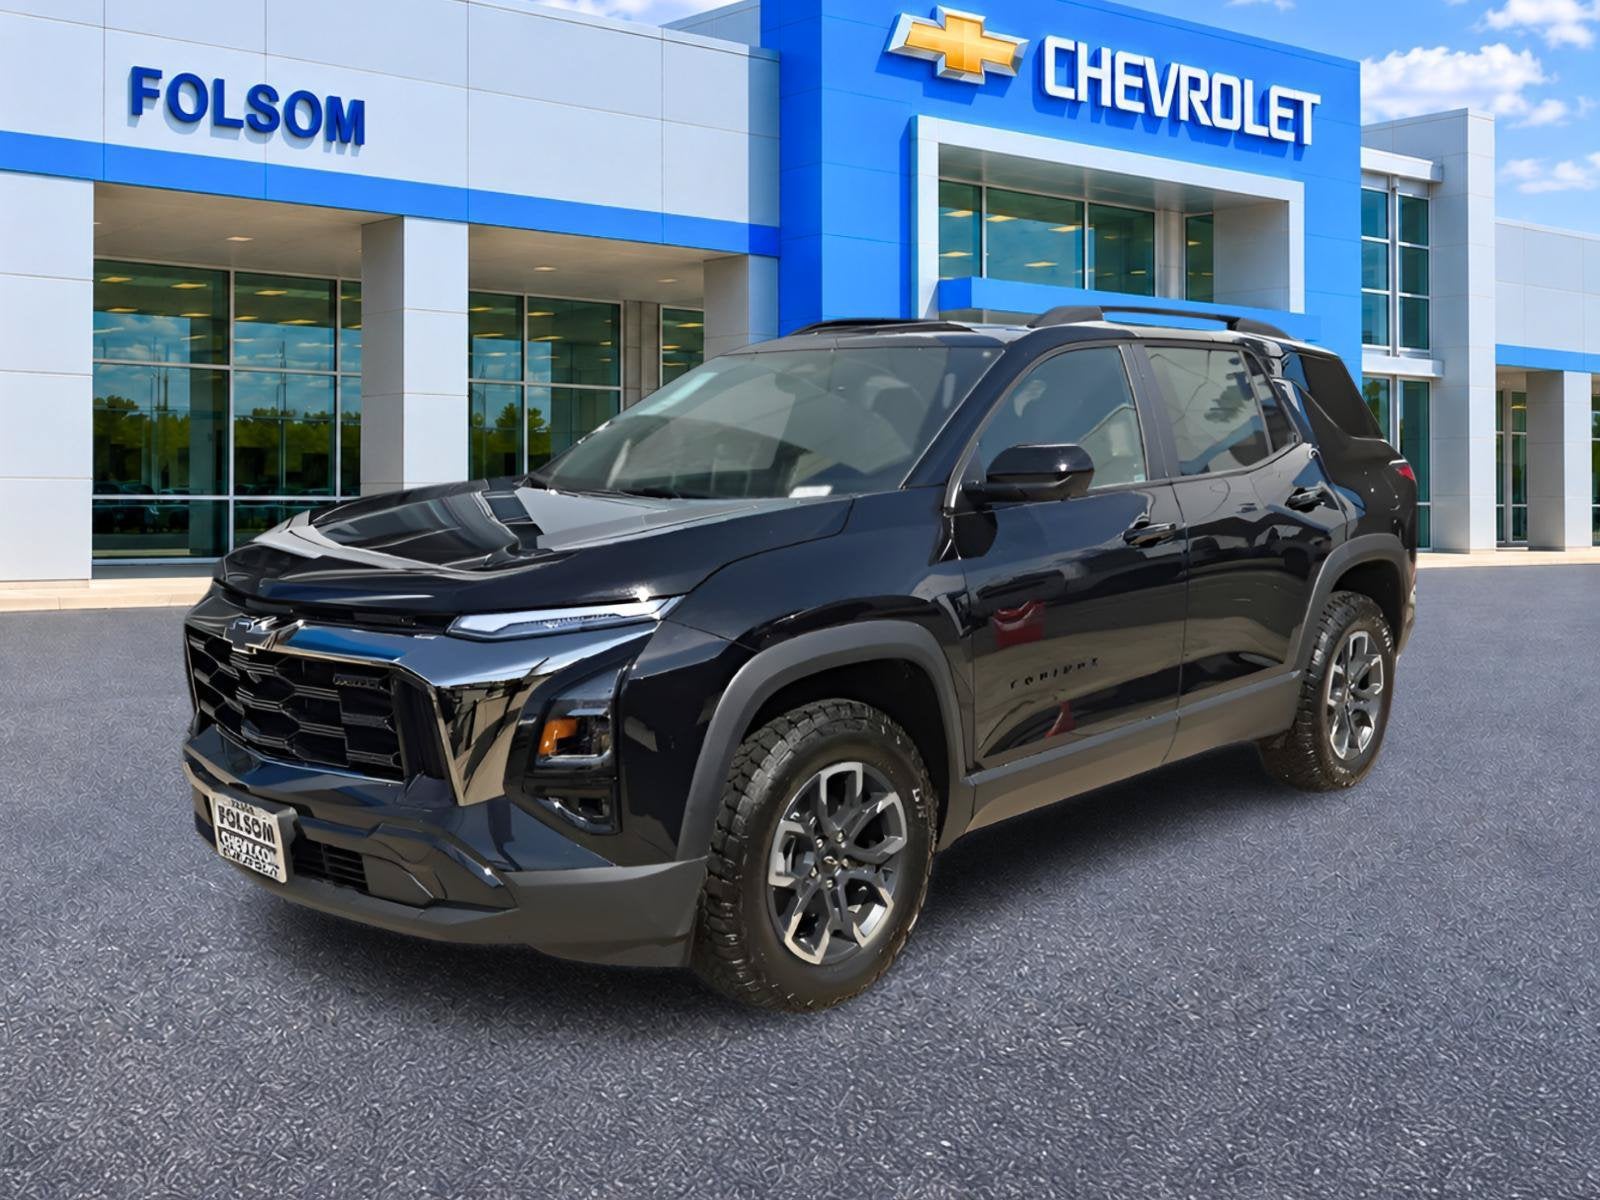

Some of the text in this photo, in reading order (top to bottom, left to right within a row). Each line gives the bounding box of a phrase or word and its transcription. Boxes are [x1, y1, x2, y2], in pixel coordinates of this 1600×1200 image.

[131, 65, 366, 146] FOLSOM
[1043, 35, 1321, 146] CHEVROLET
[217, 804, 275, 844] FOLSOM
